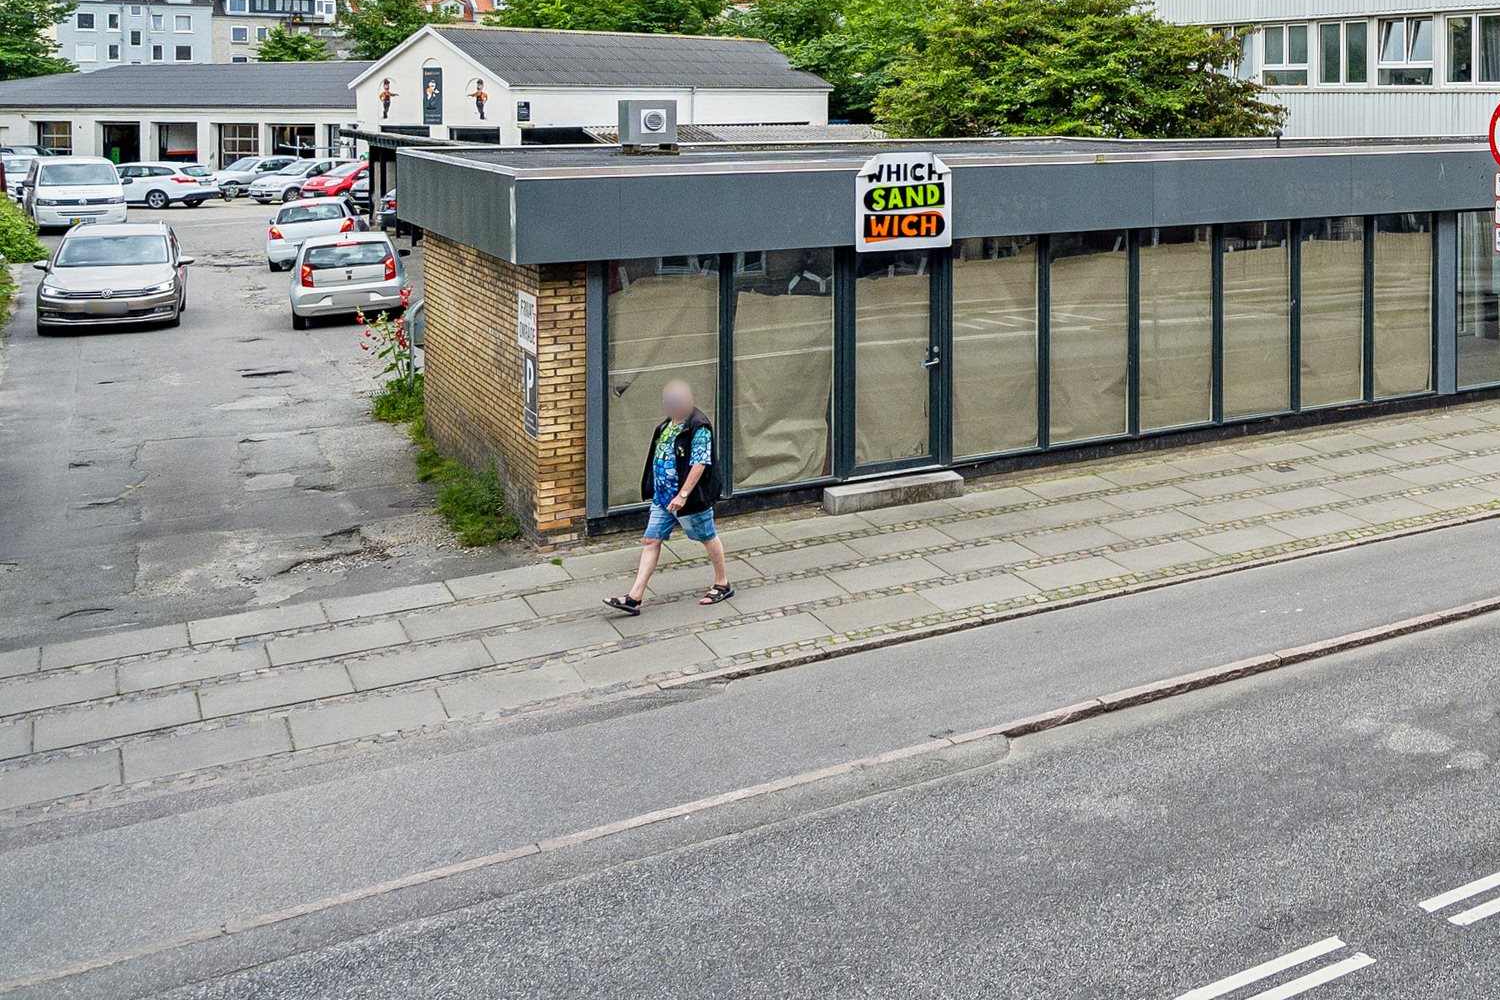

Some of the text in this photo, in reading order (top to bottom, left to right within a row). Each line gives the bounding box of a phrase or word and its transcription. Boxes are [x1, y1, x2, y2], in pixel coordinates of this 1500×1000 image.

[868, 163, 943, 183] WHICH
[871, 184, 940, 211] SAND
[870, 215, 937, 236] WICH
